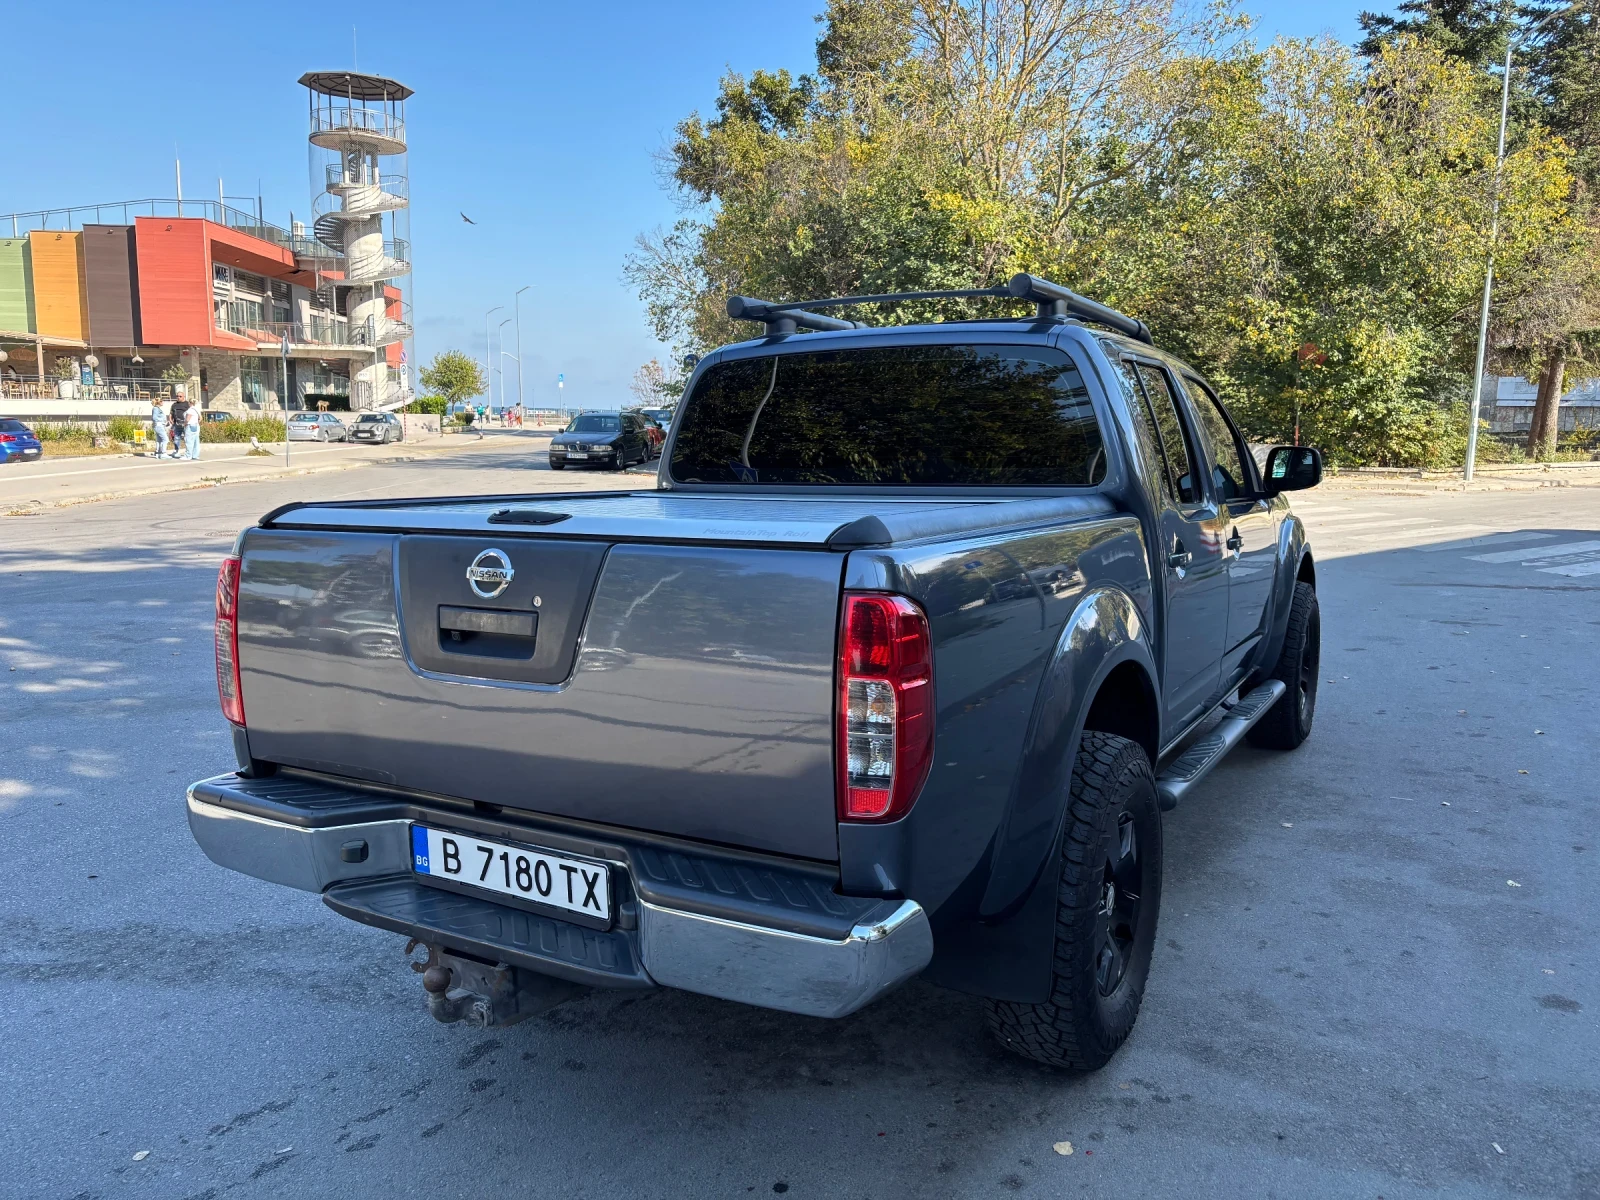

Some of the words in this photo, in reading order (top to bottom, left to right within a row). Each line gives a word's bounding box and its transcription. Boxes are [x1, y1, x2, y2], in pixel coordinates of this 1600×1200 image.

[783, 530, 810, 538] Roll
[470, 569, 507, 579] NISSAN
[416, 855, 429, 866] BG
[442, 837, 462, 874] B
[477, 845, 552, 897] 7180
[559, 863, 602, 911] TX
